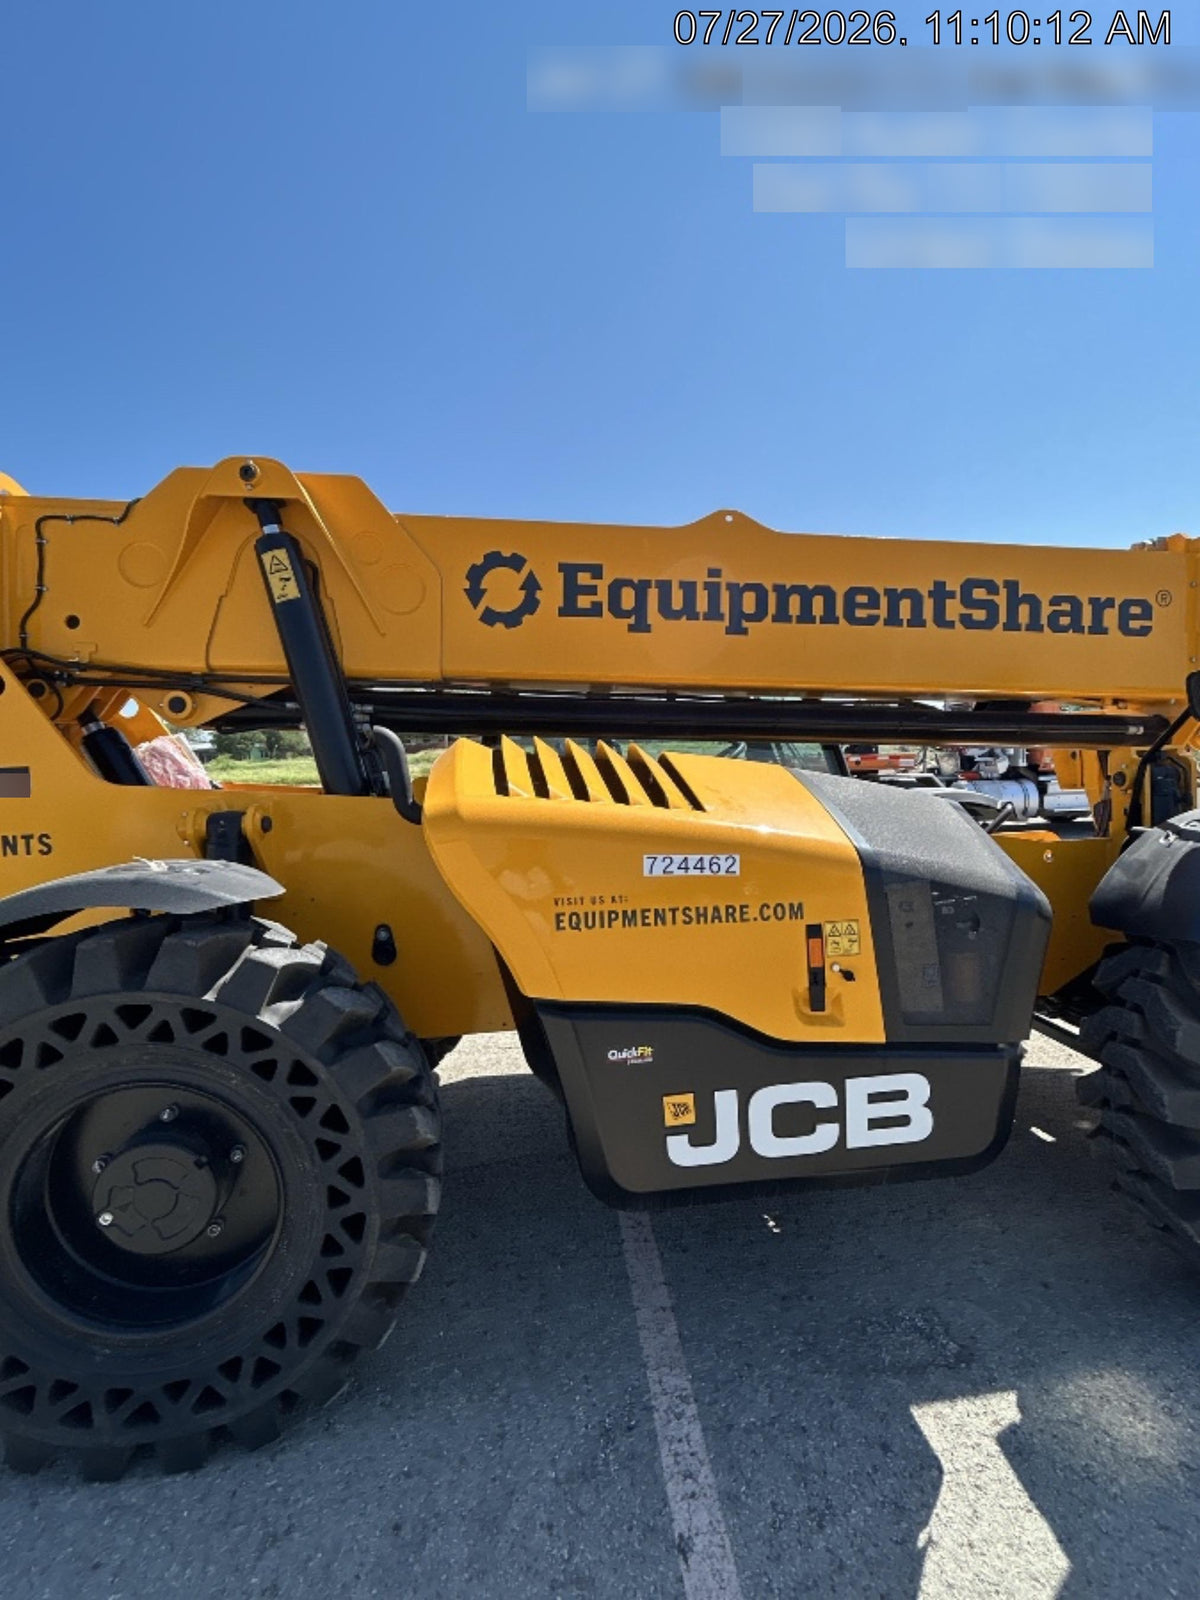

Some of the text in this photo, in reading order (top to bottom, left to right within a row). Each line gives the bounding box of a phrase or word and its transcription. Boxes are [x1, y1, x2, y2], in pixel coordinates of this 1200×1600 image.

[645, 855, 737, 875] 724462
[553, 896, 584, 907] VISIT
[590, 895, 605, 906] US
[554, 902, 806, 932] EQUIPMENTSHARE.COM
[664, 1073, 934, 1167] JCB
